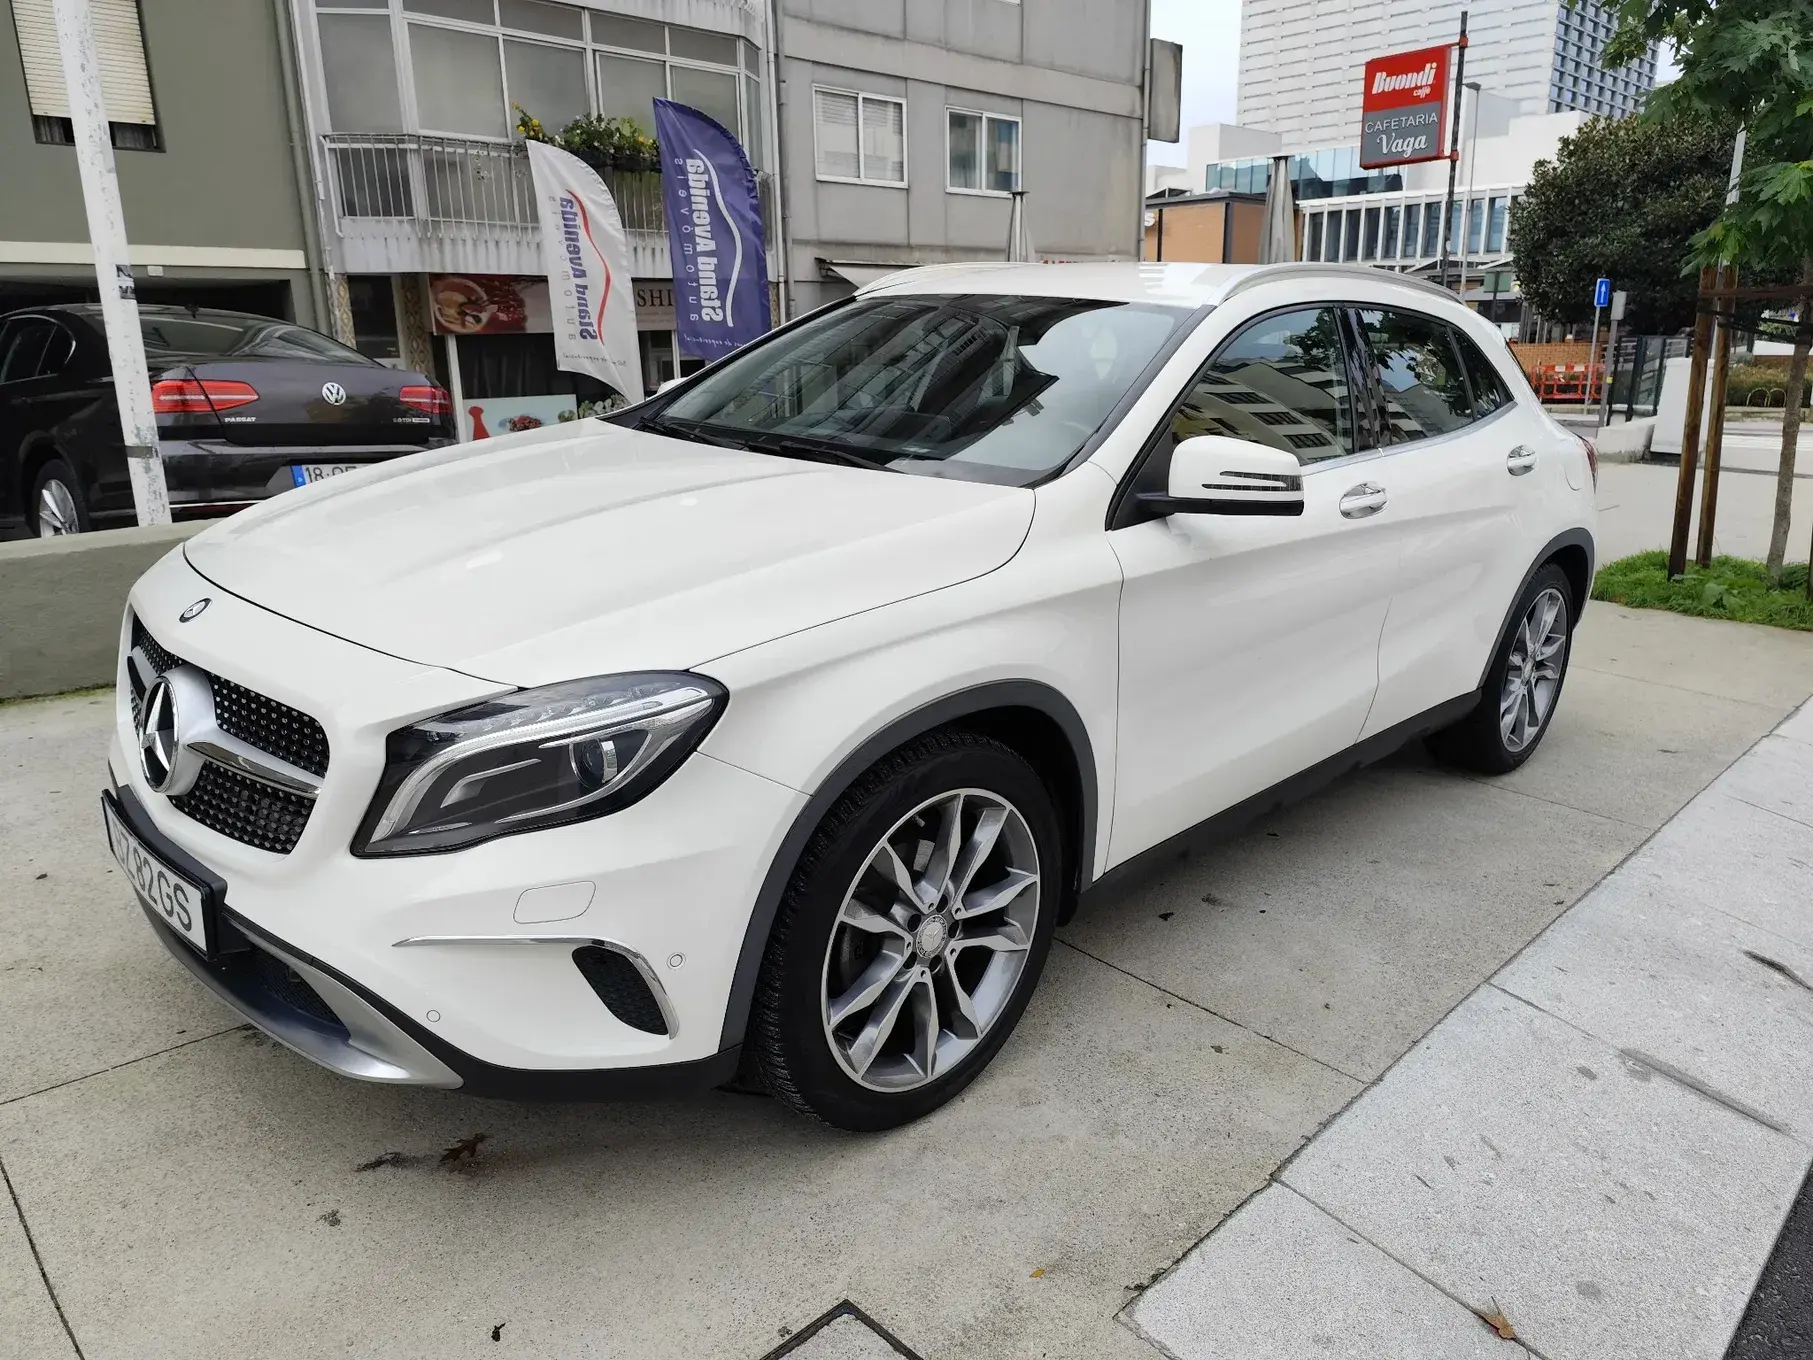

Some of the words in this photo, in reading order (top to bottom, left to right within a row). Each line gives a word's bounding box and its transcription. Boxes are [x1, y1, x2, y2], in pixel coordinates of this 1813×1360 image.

[1372, 62, 1438, 94] Buondi
[1365, 112, 1439, 133] CAFETARIA
[1377, 132, 1428, 158] Vaga
